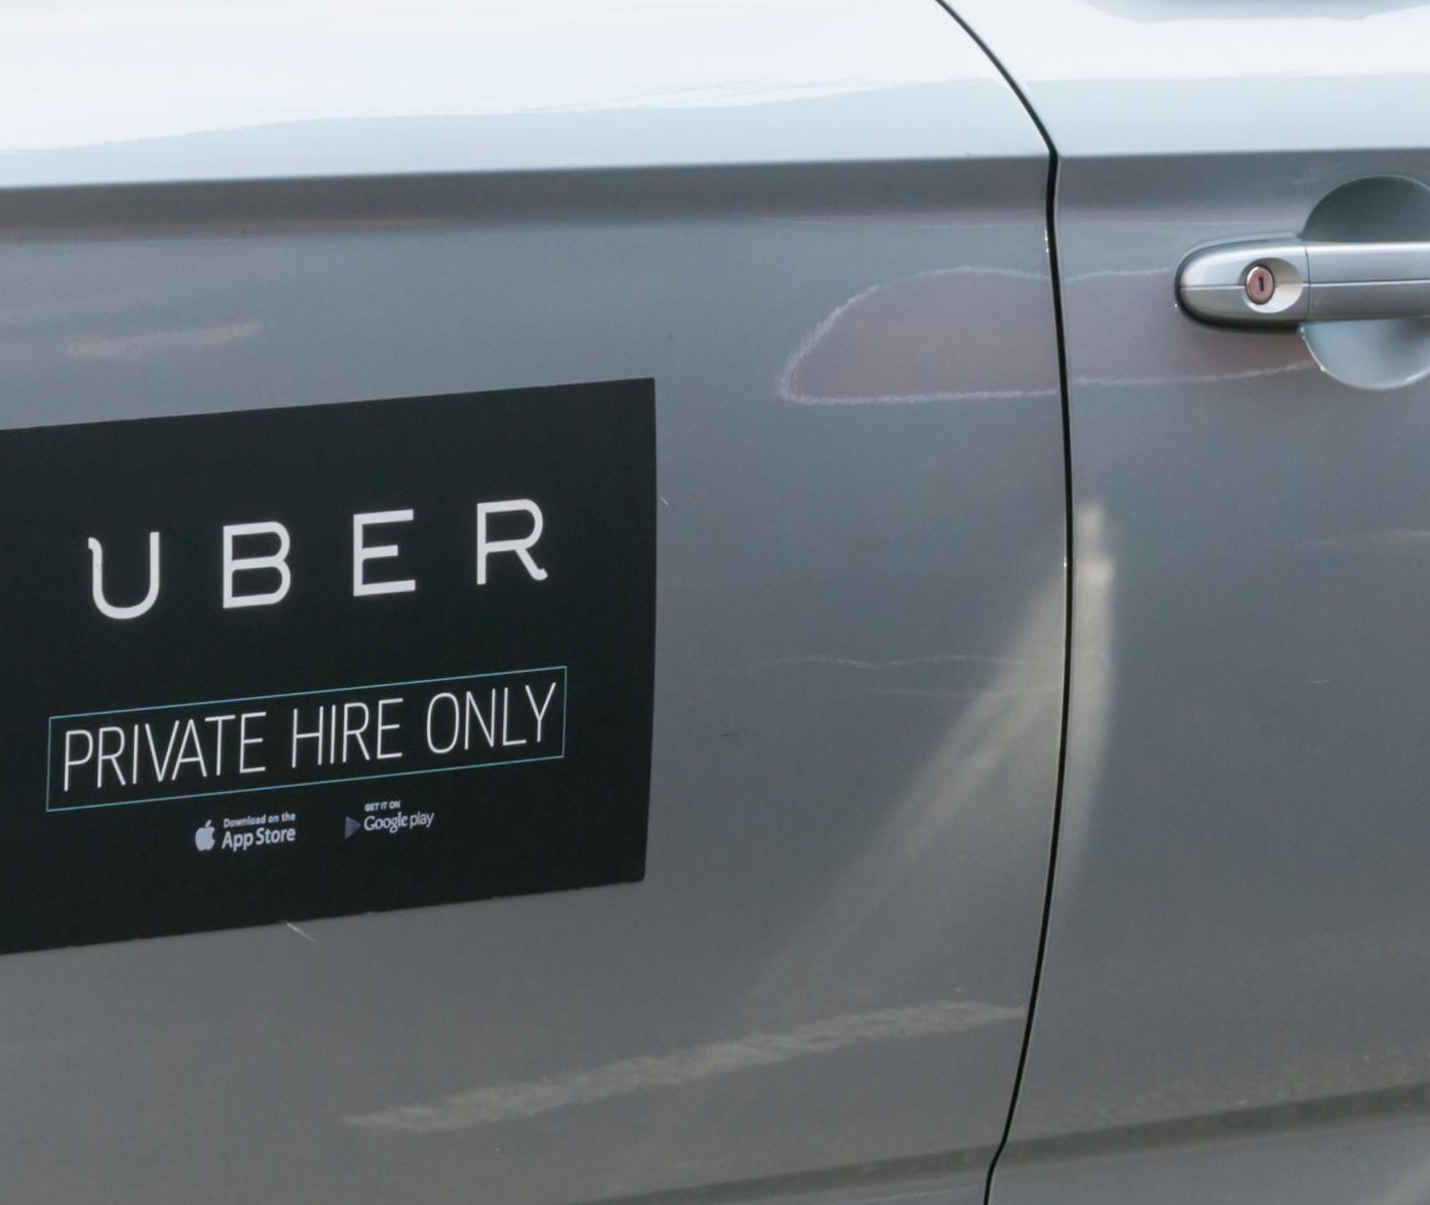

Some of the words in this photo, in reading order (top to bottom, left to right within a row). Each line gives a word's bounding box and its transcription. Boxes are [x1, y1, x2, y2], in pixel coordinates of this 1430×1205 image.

[87, 498, 548, 620] UBER
[63, 711, 267, 793] PRIVATE
[291, 697, 404, 770] HIRE
[425, 682, 556, 755] ONLY
[364, 802, 380, 812] GET
[380, 801, 388, 810] IT
[388, 799, 401, 810] ON
[223, 813, 267, 829] Download
[267, 814, 280, 824] on
[280, 811, 296, 822] the
[363, 811, 409, 834] Google
[409, 810, 435, 830] play
[221, 830, 255, 853] App
[255, 826, 297, 846] Store
